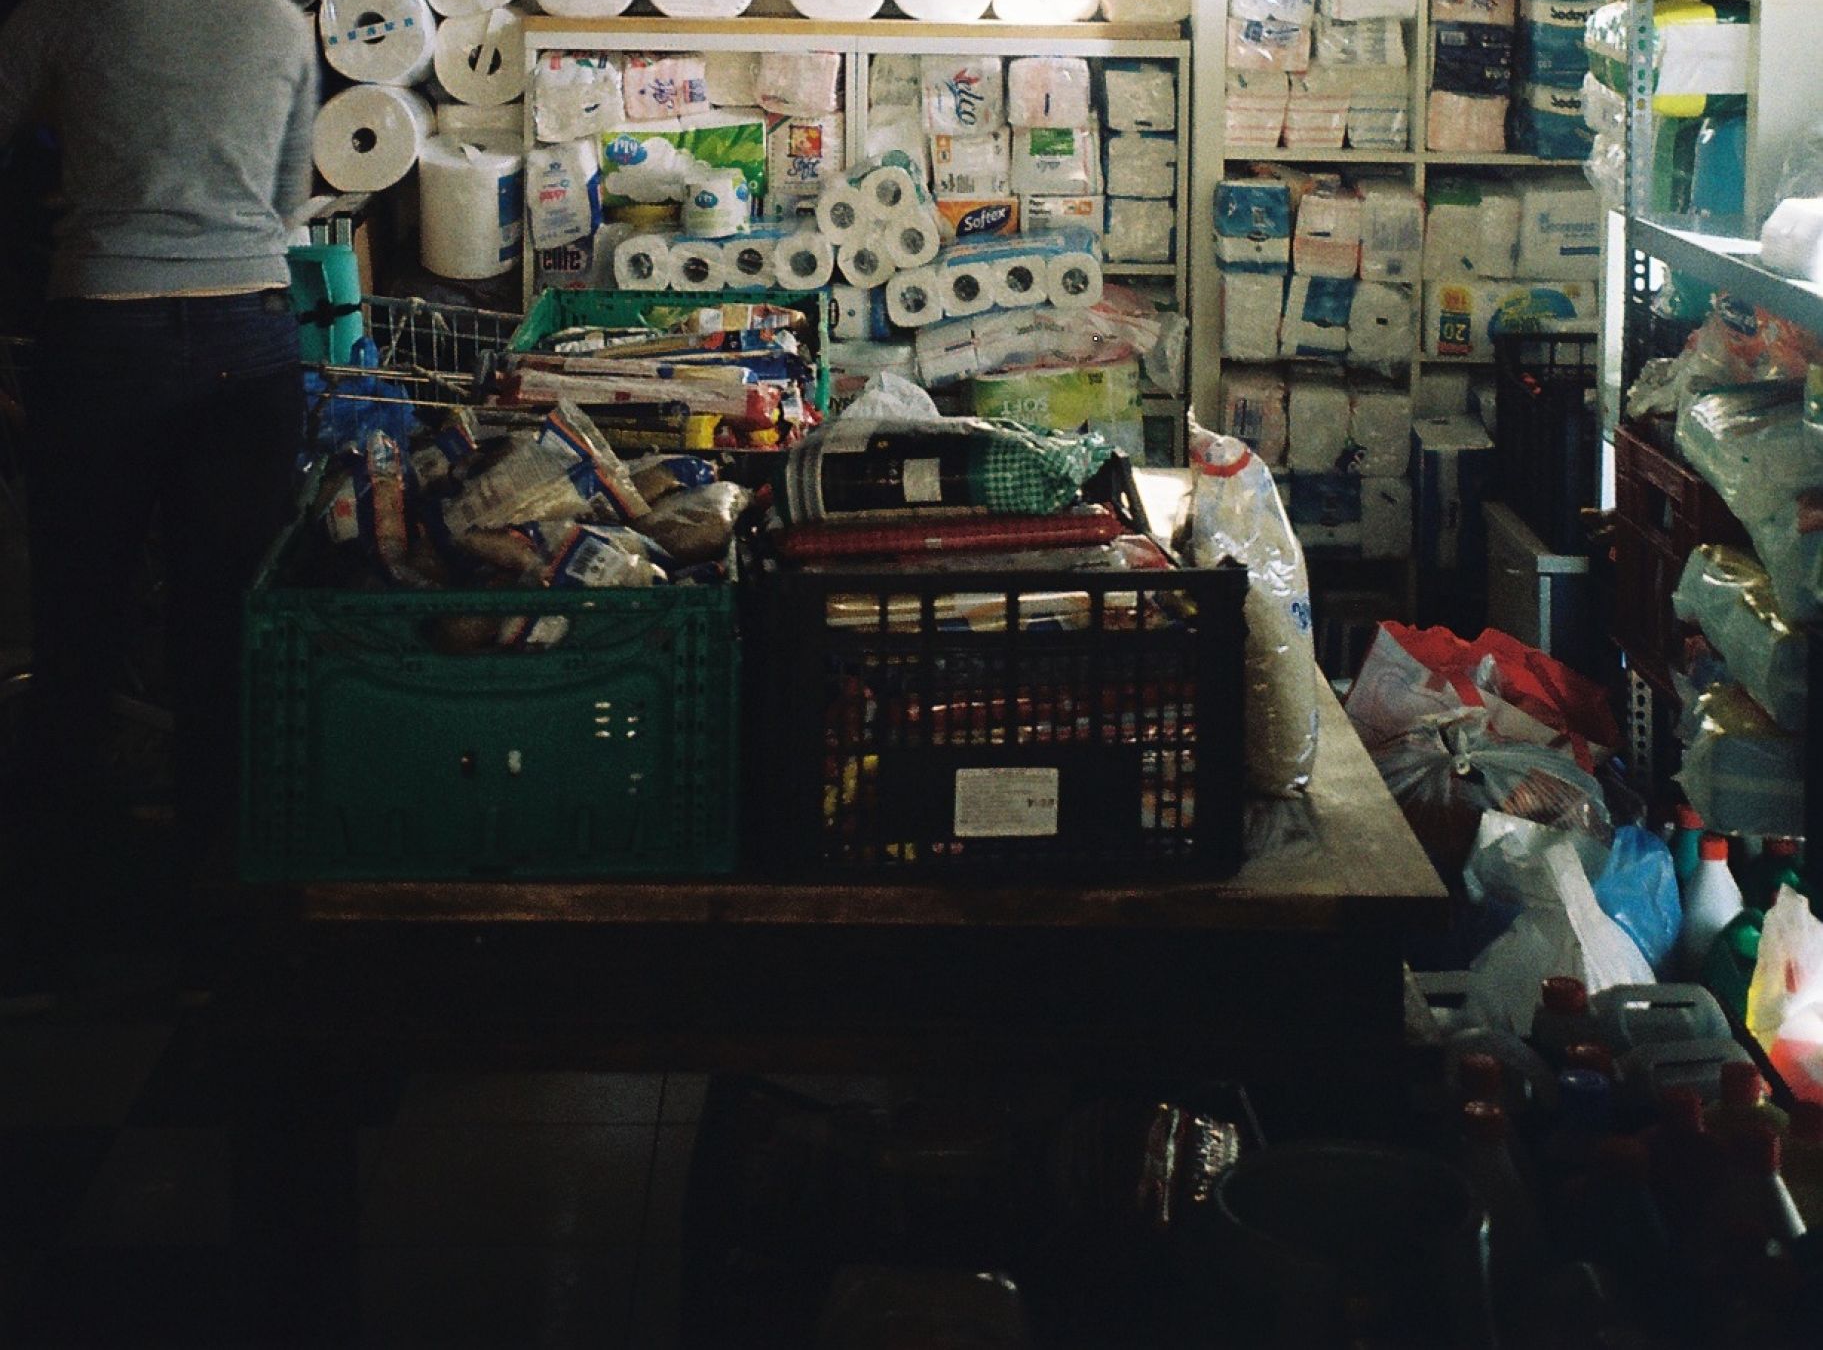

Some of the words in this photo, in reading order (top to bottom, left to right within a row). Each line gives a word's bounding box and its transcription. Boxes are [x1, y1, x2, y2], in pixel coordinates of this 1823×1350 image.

[964, 208, 1007, 231] Softex
[542, 246, 581, 271] elite
[1001, 397, 1048, 416] SOFT
